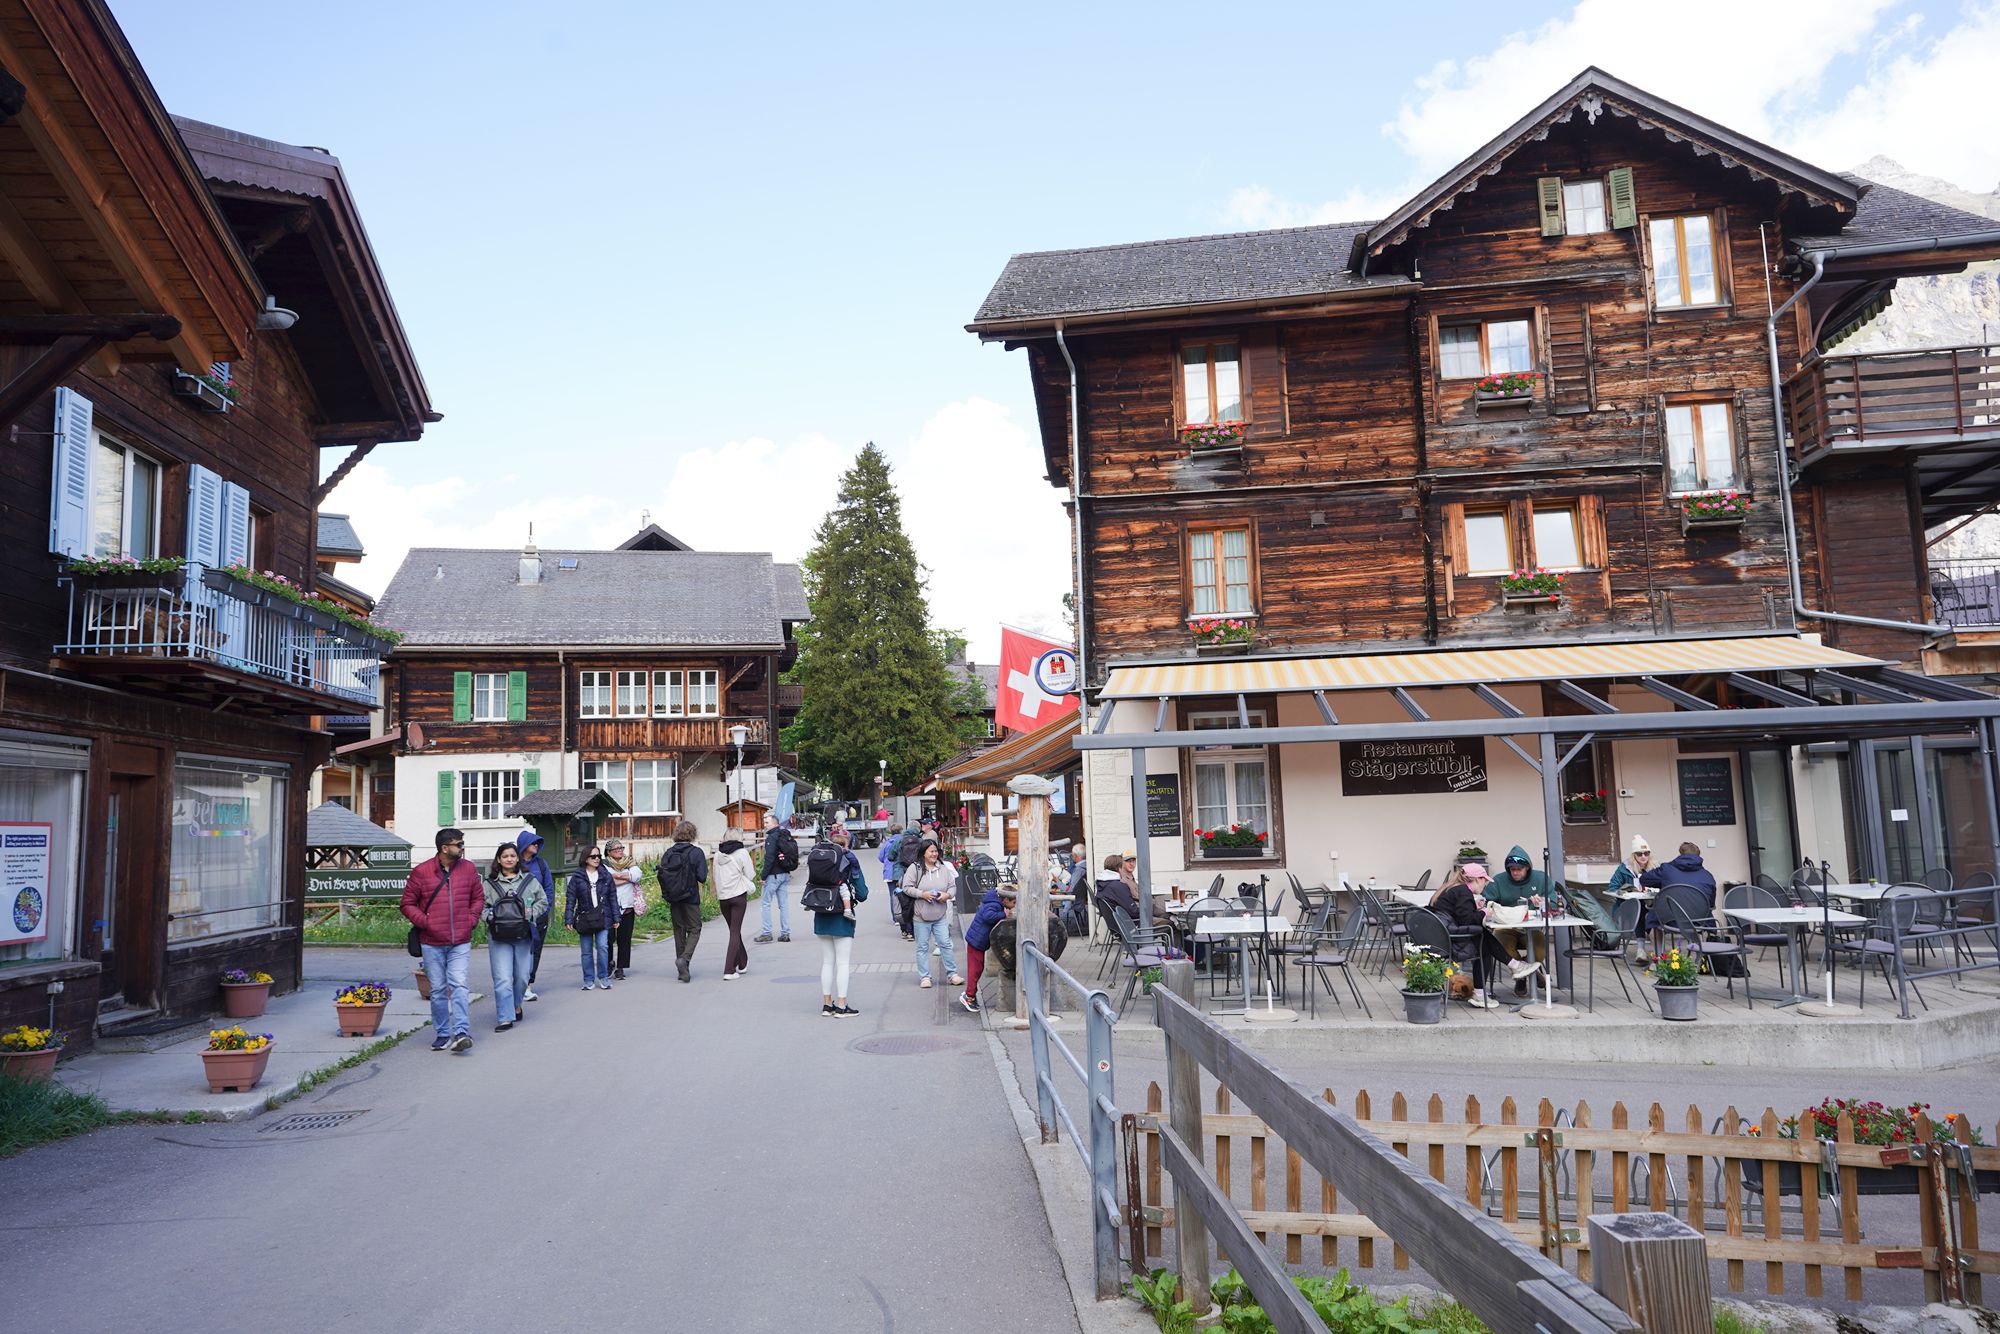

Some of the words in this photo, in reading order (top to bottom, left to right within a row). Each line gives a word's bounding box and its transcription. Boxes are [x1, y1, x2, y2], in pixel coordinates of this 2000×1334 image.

[1361, 740, 1456, 757] Restaurant
[1348, 755, 1472, 780] Stägerstübli
[1453, 774, 1483, 789] ORIGINAL
[1459, 772, 1472, 781] DAS
[307, 876, 332, 892] Drei
[333, 878, 360, 891] Berge
[361, 876, 408, 892] Panoram
